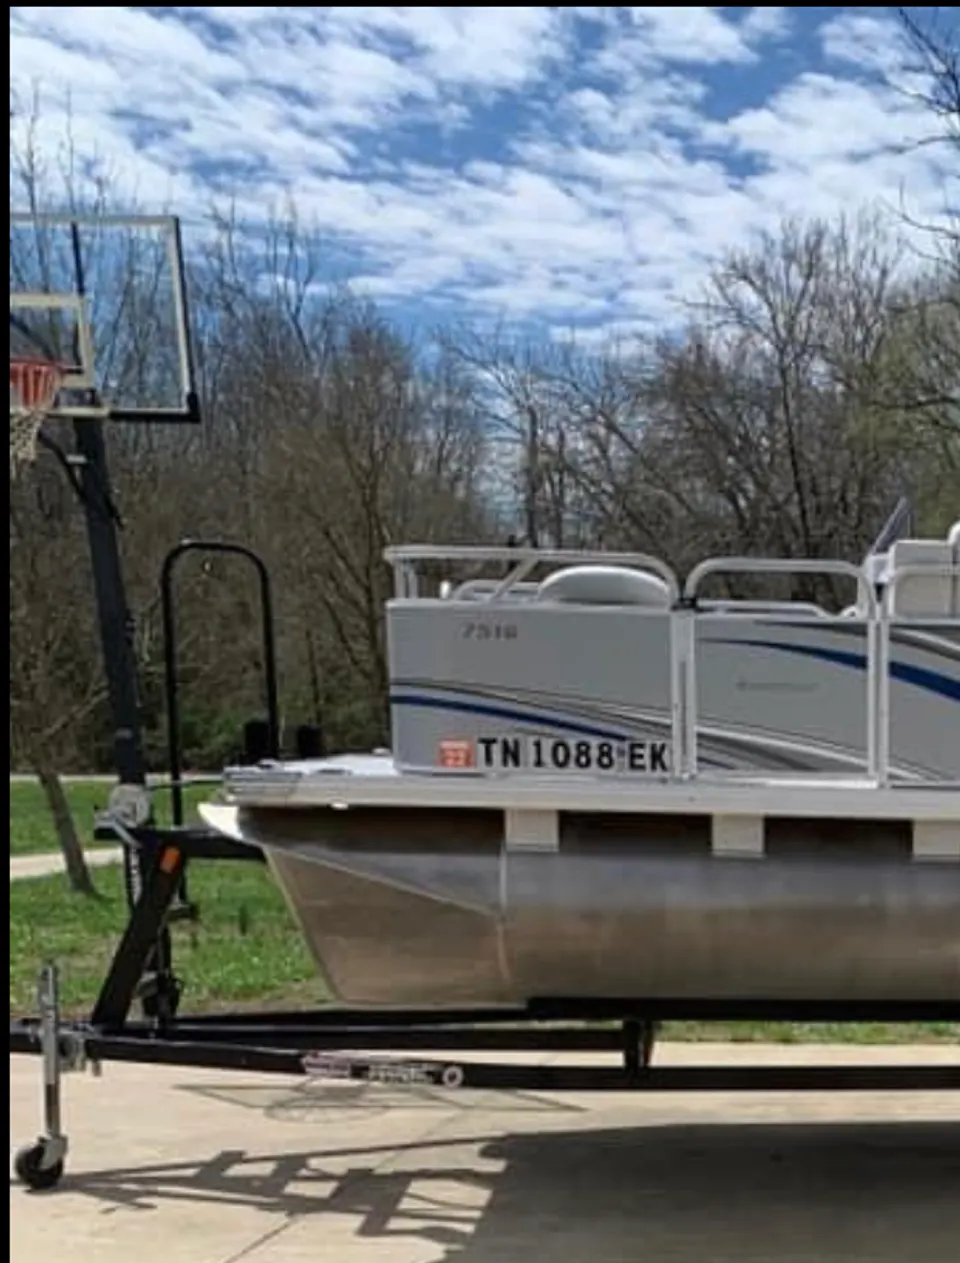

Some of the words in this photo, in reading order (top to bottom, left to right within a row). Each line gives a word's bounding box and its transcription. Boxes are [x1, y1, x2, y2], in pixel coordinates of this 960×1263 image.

[477, 737, 521, 768] TN
[533, 740, 615, 769] 1088
[629, 742, 669, 771] EK
